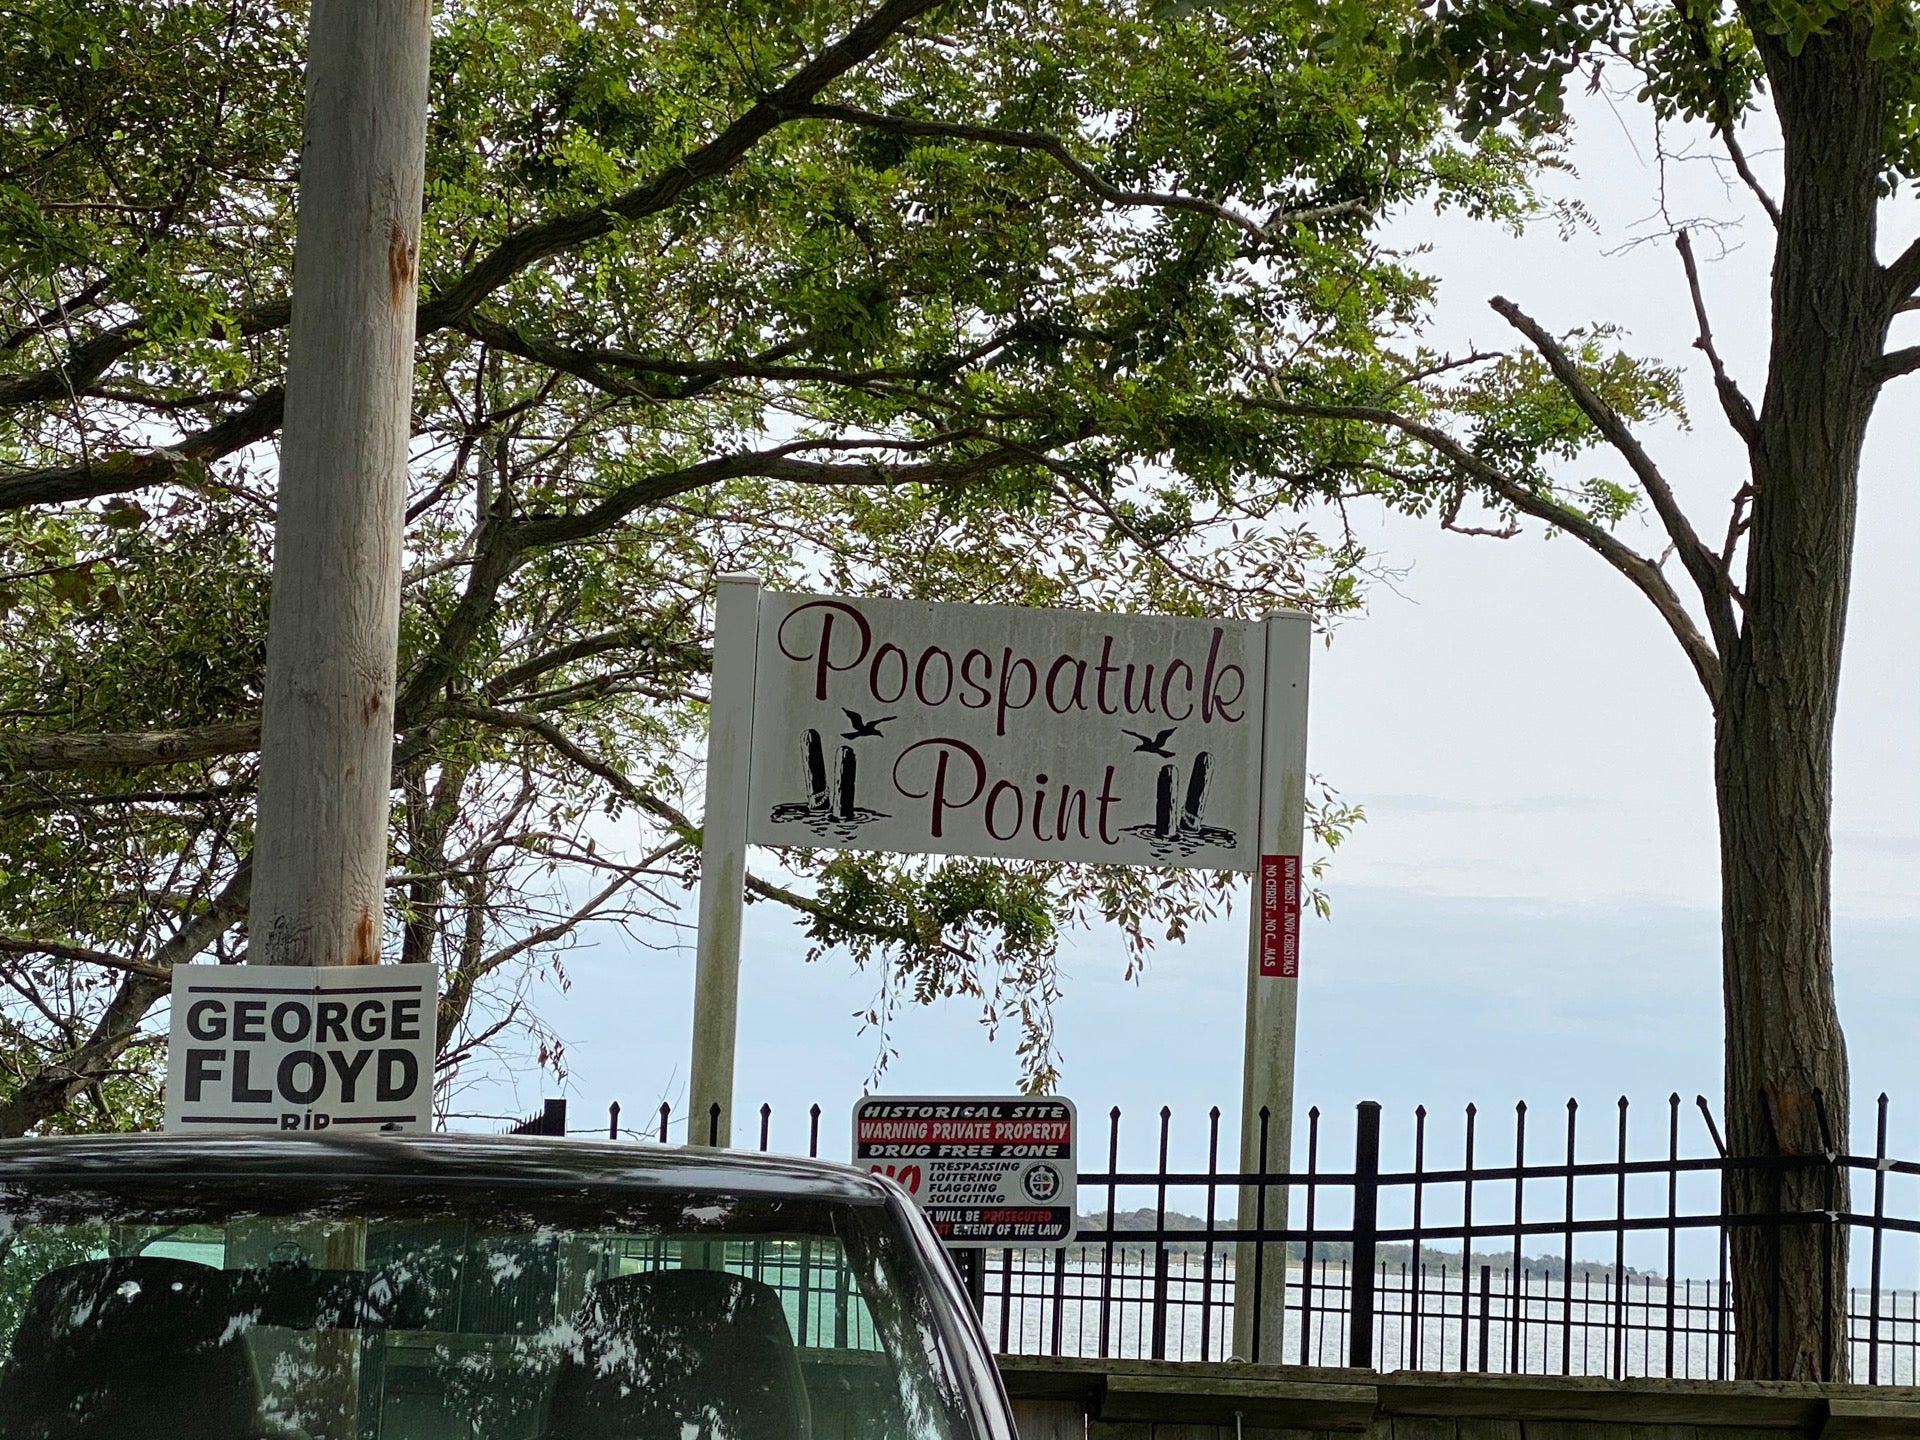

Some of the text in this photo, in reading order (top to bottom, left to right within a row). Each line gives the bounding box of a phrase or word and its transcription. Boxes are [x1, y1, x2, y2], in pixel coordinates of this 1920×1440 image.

[777, 600, 1245, 736] Poospatuck
[892, 737, 1122, 846] Point
[1265, 864, 1277, 878] NO
[1285, 858, 1296, 879] KNOW
[1265, 879, 1277, 911] CHRIST
[1284, 879, 1295, 905] CHRIST
[1265, 919, 1276, 932] NO
[1284, 912, 1295, 934] KNOW
[1283, 934, 1295, 976] CHRISTMAS
[186, 998, 421, 1043] GEORGE
[184, 1048, 419, 1105] FLOYD
[864, 1106, 1065, 1118] HISTORICAL SITE
[281, 1113, 330, 1130] RIP
[860, 1122, 1068, 1140] WARNING PRIVATE PROPERTY
[869, 1145, 1059, 1157] DRUG FREE ZONE
[929, 1162, 1020, 1171] TRESPASSING
[928, 1173, 1002, 1182] LOITERING
[928, 1183, 997, 1193] FLAGGING
[928, 1194, 1005, 1203] SOLICITING
[935, 1210, 962, 1222] WILL
[965, 1210, 980, 1222] BE
[983, 1210, 1052, 1222] PROSECUTED
[996, 1223, 1011, 1236] OF
[1014, 1223, 1035, 1236] THE
[1037, 1223, 1062, 1236] LAW
